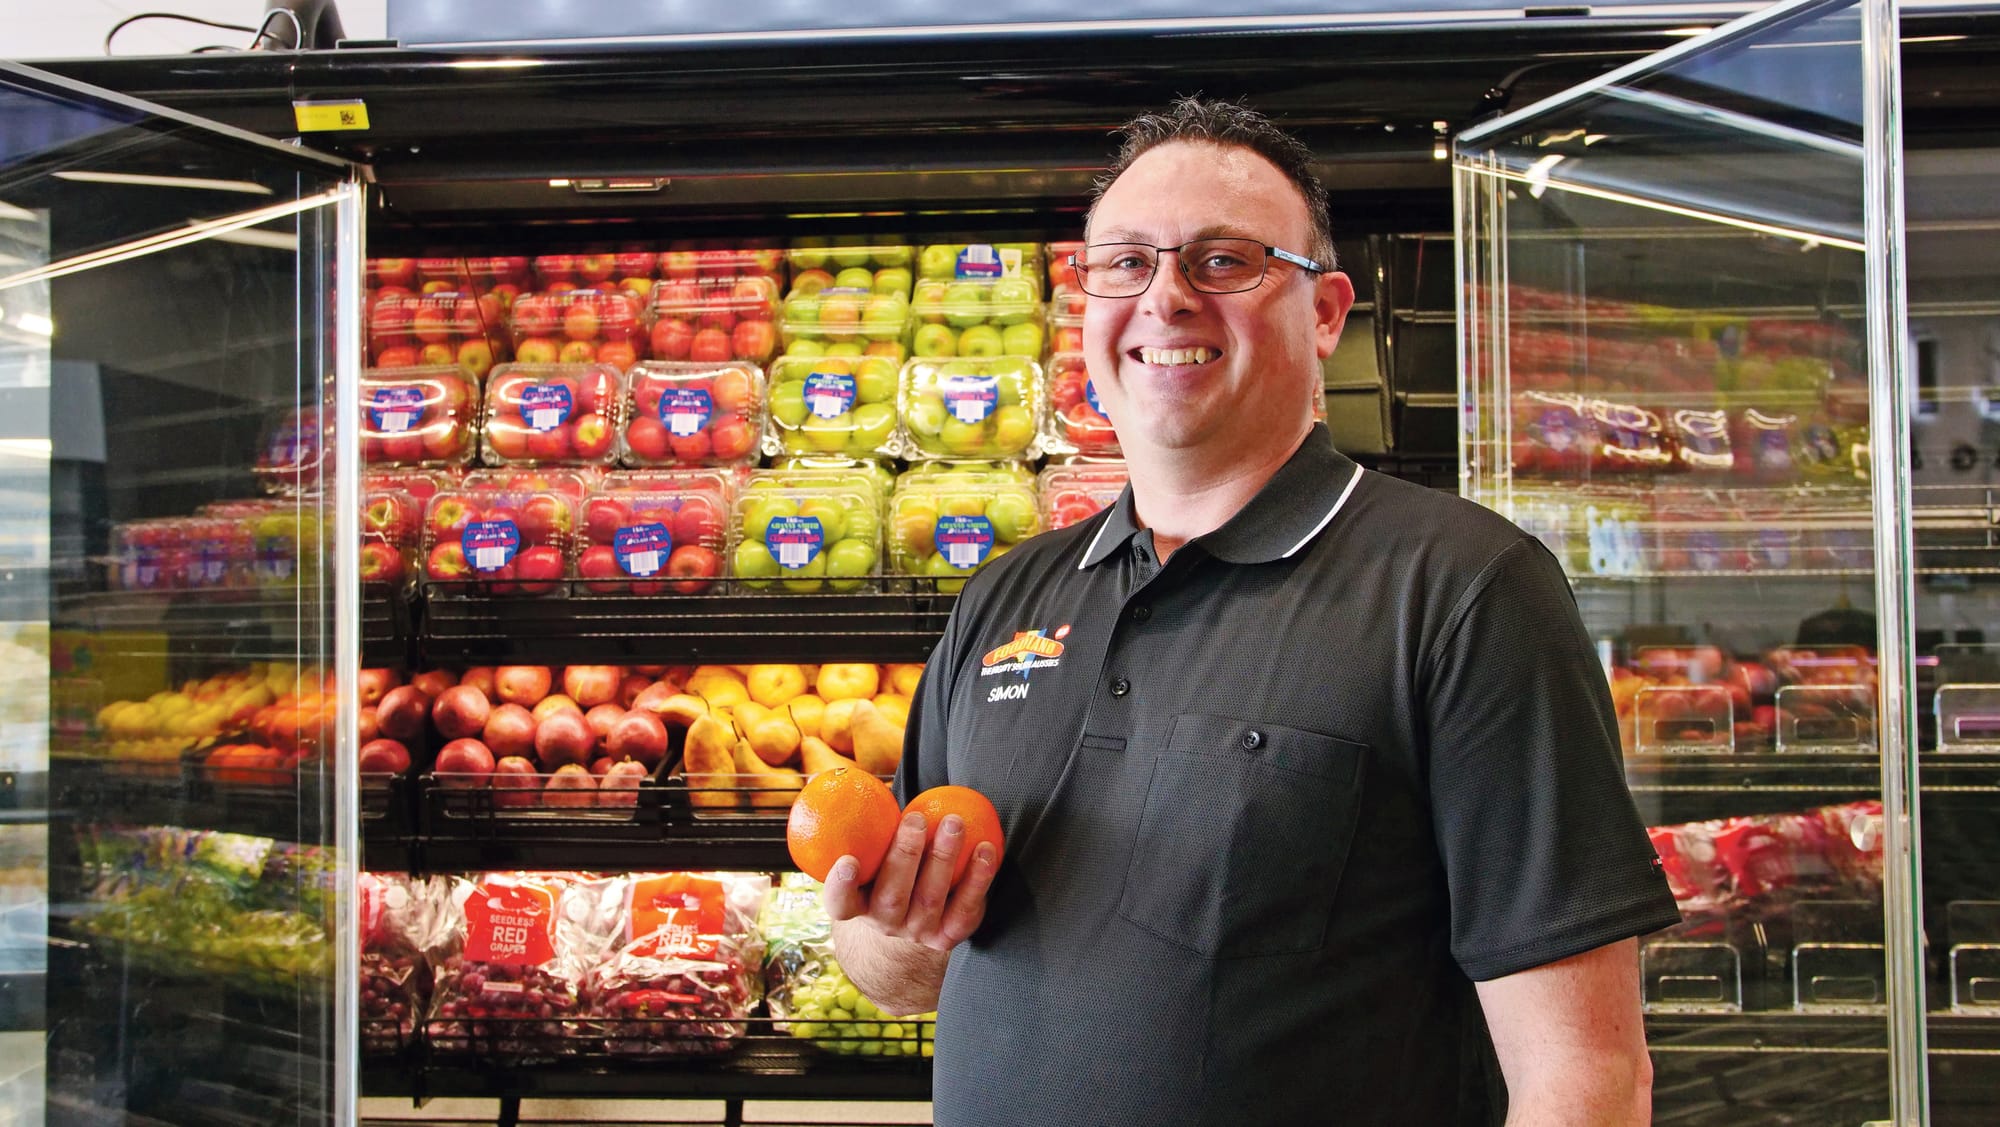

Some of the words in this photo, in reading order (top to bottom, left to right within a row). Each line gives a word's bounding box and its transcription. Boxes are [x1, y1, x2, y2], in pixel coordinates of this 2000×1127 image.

[992, 634, 1056, 663] FOODLAND
[987, 682, 1030, 703] SIMON
[489, 914, 535, 927] SEEDLESS
[492, 925, 528, 944] RED
[658, 931, 693, 947] RED
[489, 942, 527, 954] GRAPES
